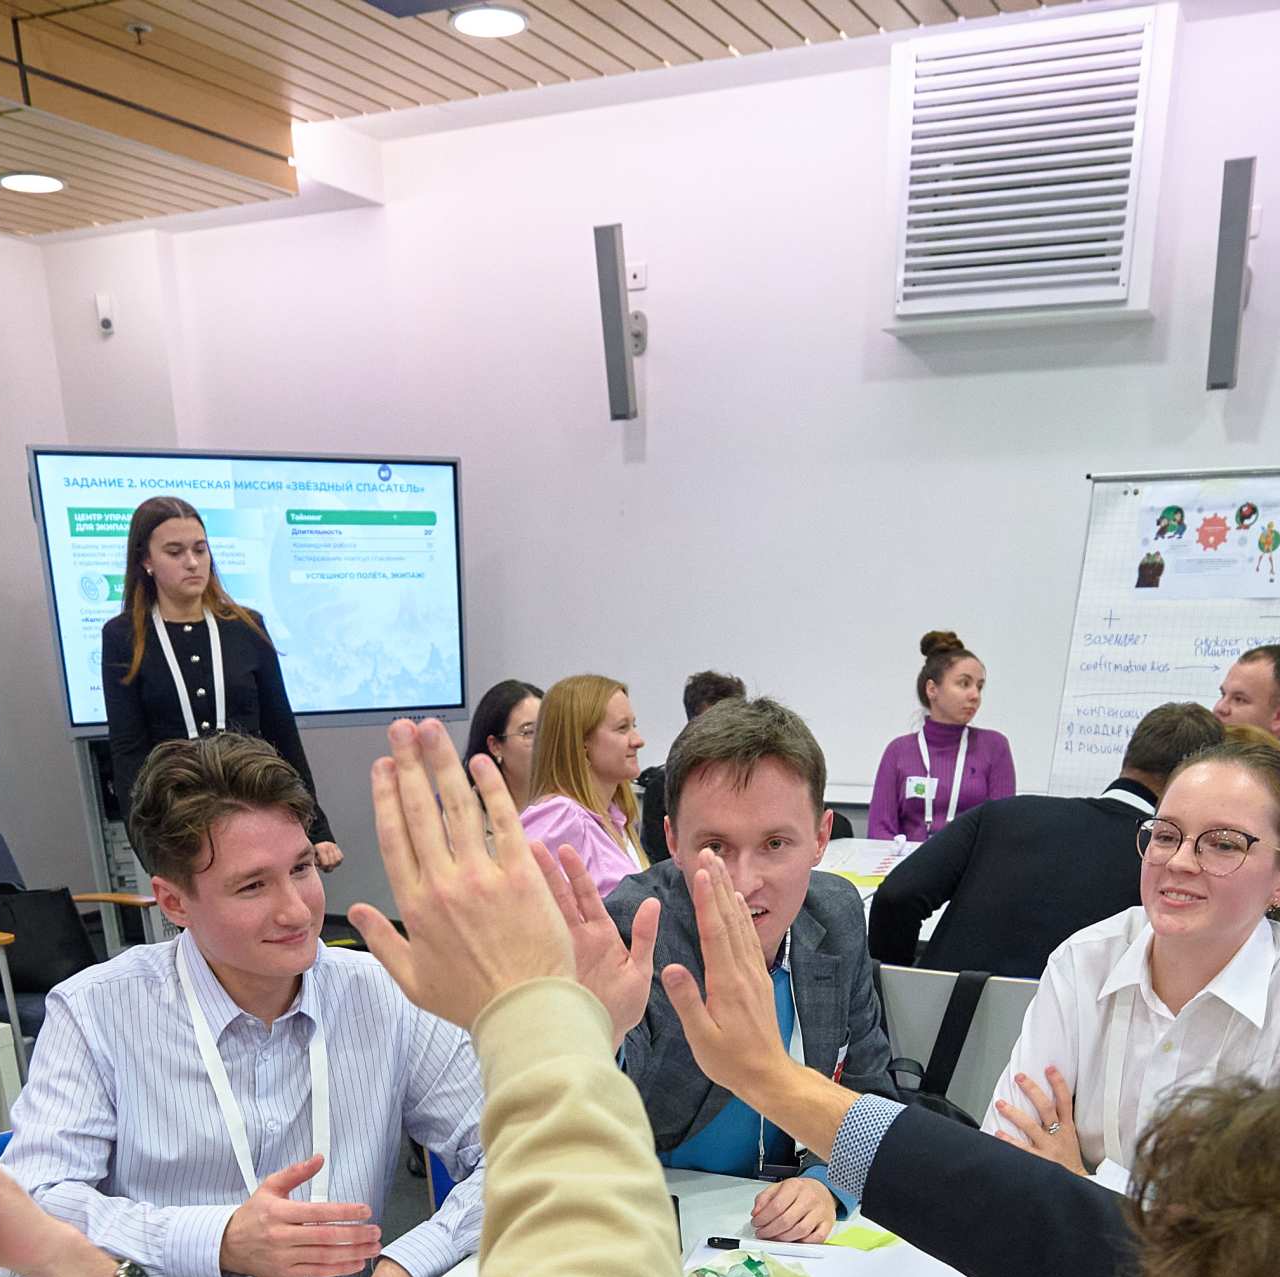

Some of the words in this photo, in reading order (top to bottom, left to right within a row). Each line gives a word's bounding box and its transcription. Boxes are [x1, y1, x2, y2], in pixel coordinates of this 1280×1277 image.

[63, 477, 124, 489] ЗАДАНИЕ
[127, 478, 137, 488] 2.
[140, 478, 231, 489] КОСМИЧЕСКАЯ
[233, 480, 283, 491] МИССИЯ
[286, 480, 353, 492] «ЗВЁЗДНЫЙ
[356, 482, 425, 494] СПАСАТЕЛЬ»
[291, 528, 342, 536] Длительность
